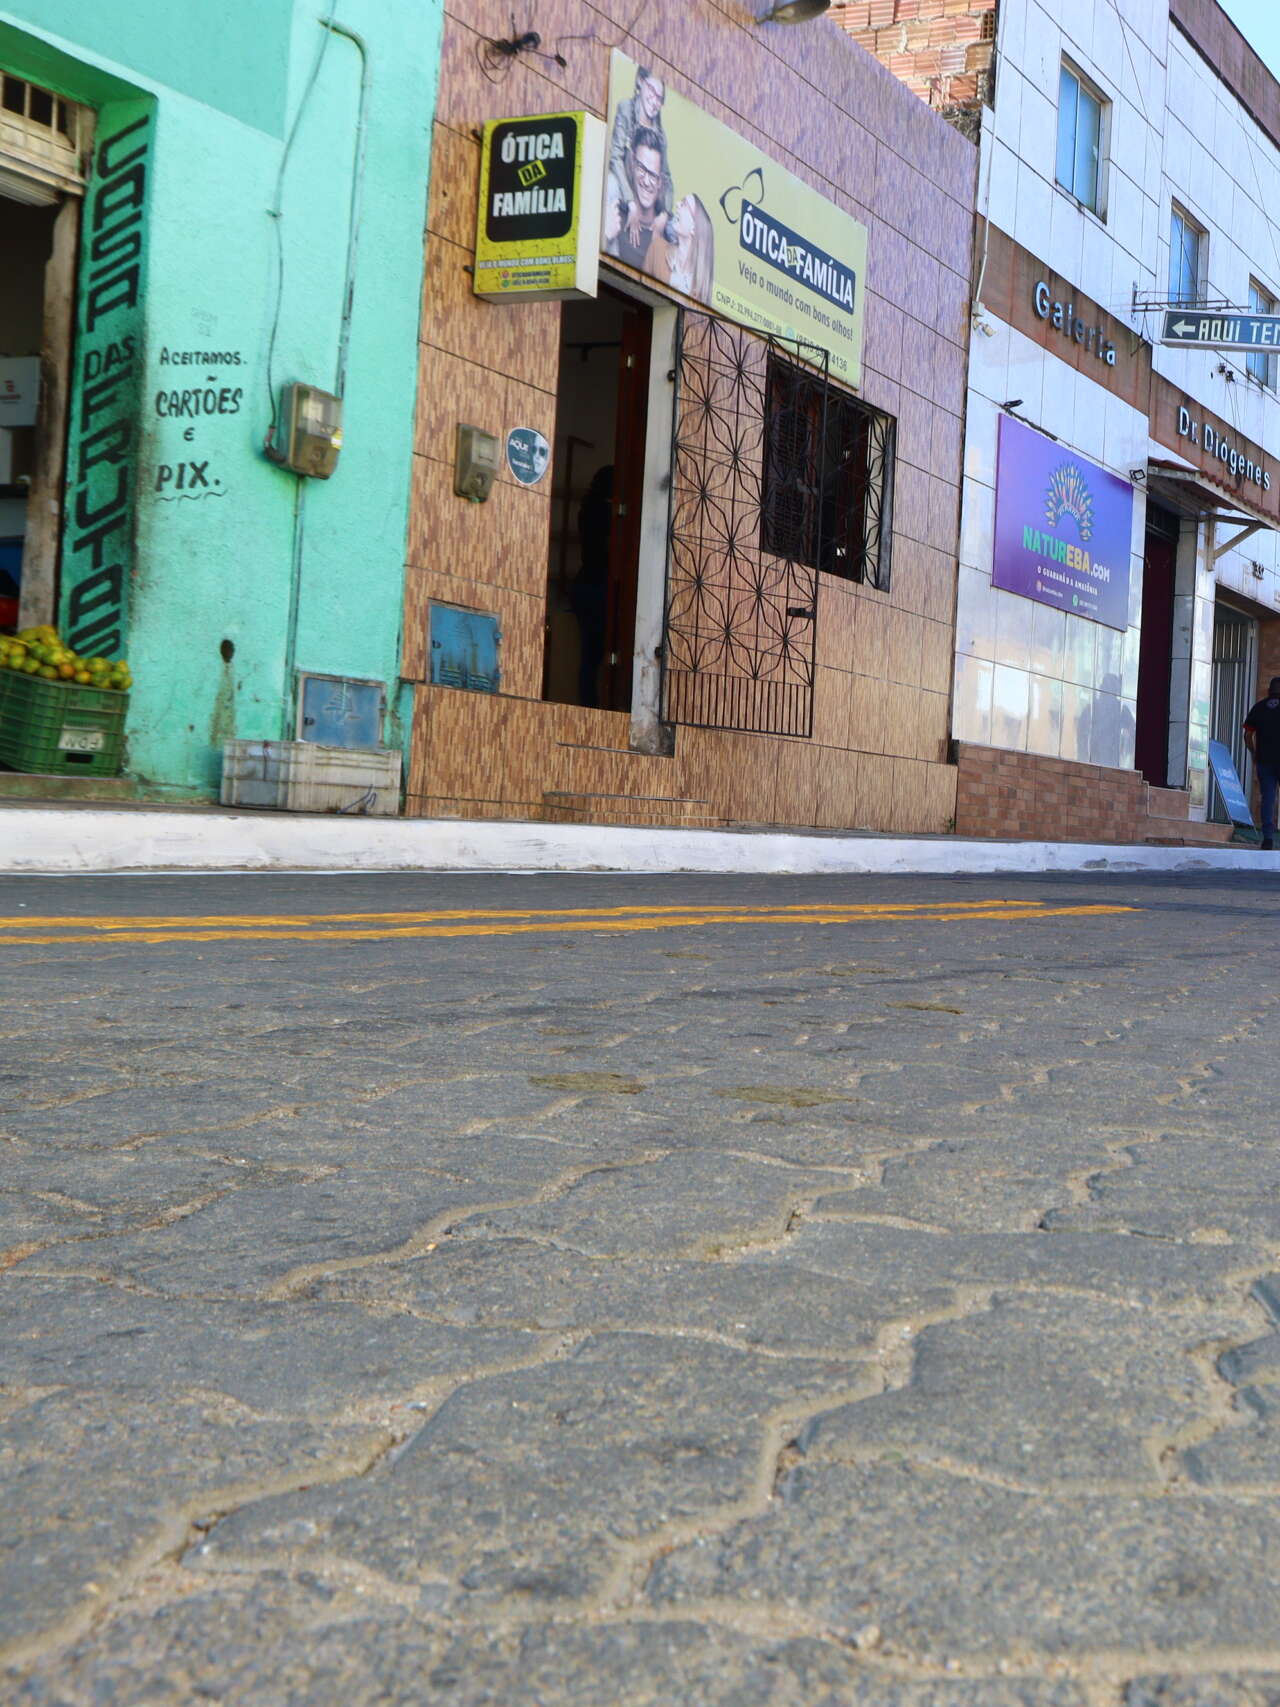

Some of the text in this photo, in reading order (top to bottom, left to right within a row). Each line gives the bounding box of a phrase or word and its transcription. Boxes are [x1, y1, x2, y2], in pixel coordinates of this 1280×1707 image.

[501, 132, 565, 163] ÓTICA
[523, 163, 542, 182] DA
[86, 114, 149, 333] CASA
[493, 186, 566, 217] FAMÍLIA
[742, 204, 853, 309] ÓTICA DA FAMÍLIA
[739, 261, 853, 342] Veja o mundo com bons olhos!
[1033, 280, 1117, 367] Galeria
[84, 335, 136, 382] DAS
[156, 375, 244, 418] CARTÕES
[1177, 406, 1271, 491] Dr. Diógenes
[67, 364, 133, 660] FRUTAS
[1023, 525, 1110, 584] NATUREBA.COM
[1043, 567, 1066, 584] GUARANÁ
